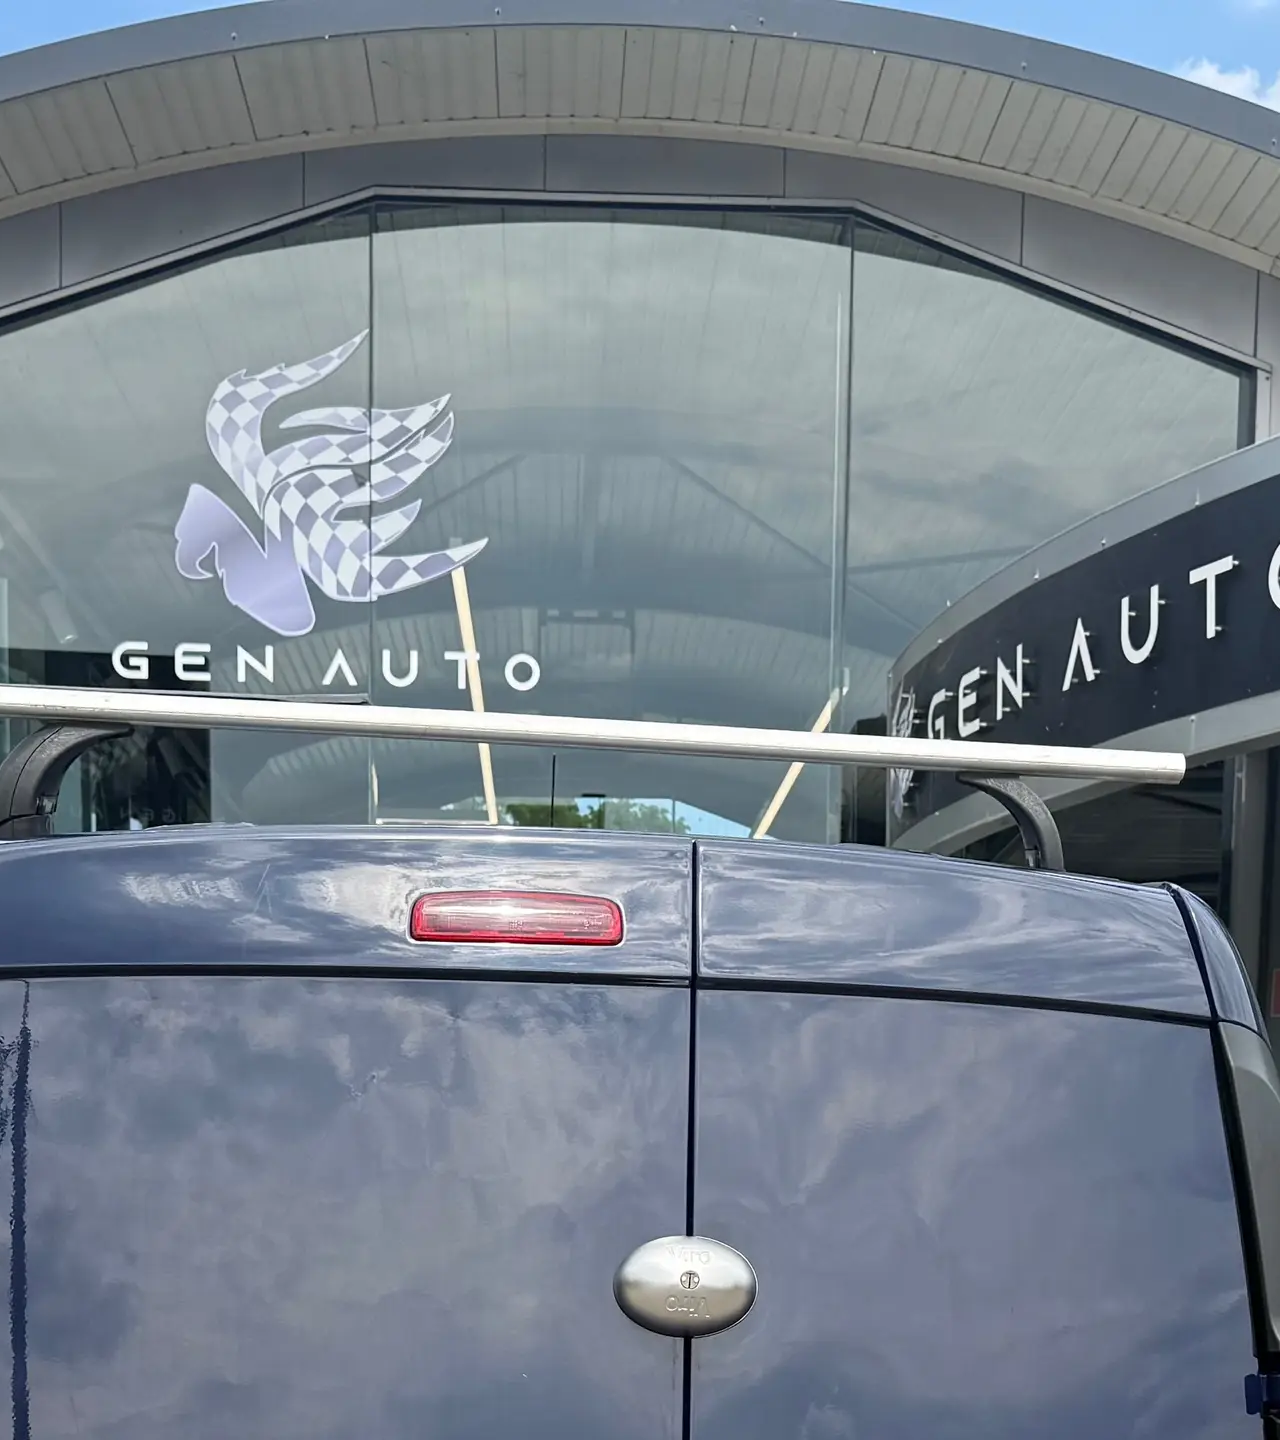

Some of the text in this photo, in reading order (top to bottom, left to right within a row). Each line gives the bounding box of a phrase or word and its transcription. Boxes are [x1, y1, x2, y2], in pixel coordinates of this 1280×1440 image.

[112, 641, 541, 691] GEN AUTO
[927, 644, 1024, 740] GEN
